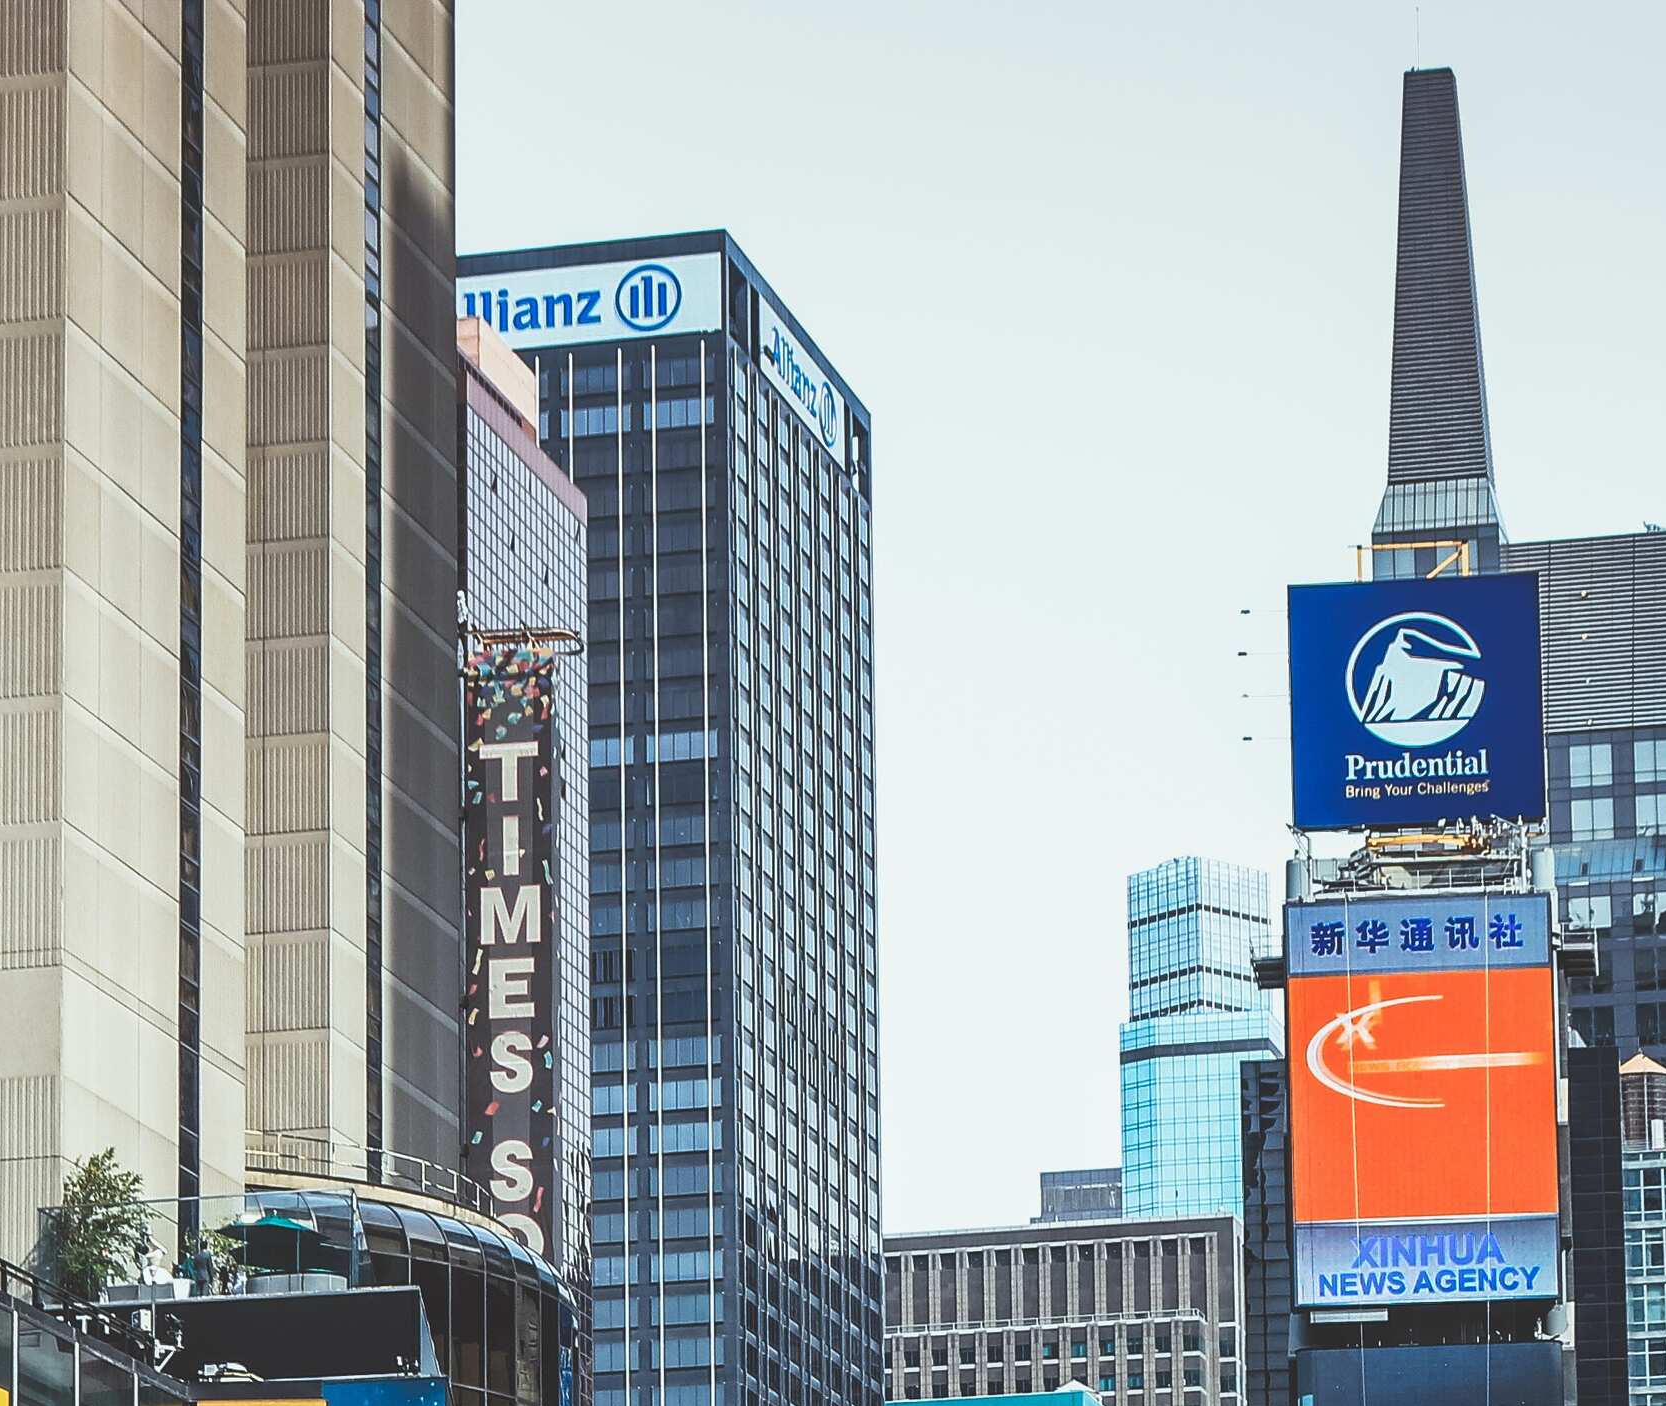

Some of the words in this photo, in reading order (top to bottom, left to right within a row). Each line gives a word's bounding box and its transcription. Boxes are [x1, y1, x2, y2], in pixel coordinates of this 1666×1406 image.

[463, 289, 601, 334] llianz
[771, 326, 819, 418] Allianz
[1345, 750, 1489, 781] Prudential
[1345, 782, 1382, 799] Bring
[1385, 781, 1414, 798] Your
[1416, 778, 1490, 796] Challenges
[479, 741, 541, 1093] TIMES
[1311, 913, 1525, 956] 新华通讯社
[1352, 1231, 1505, 1270] XINHUA
[1318, 1272, 1404, 1298] NEWS
[1412, 1265, 1541, 1294] AGENCY
